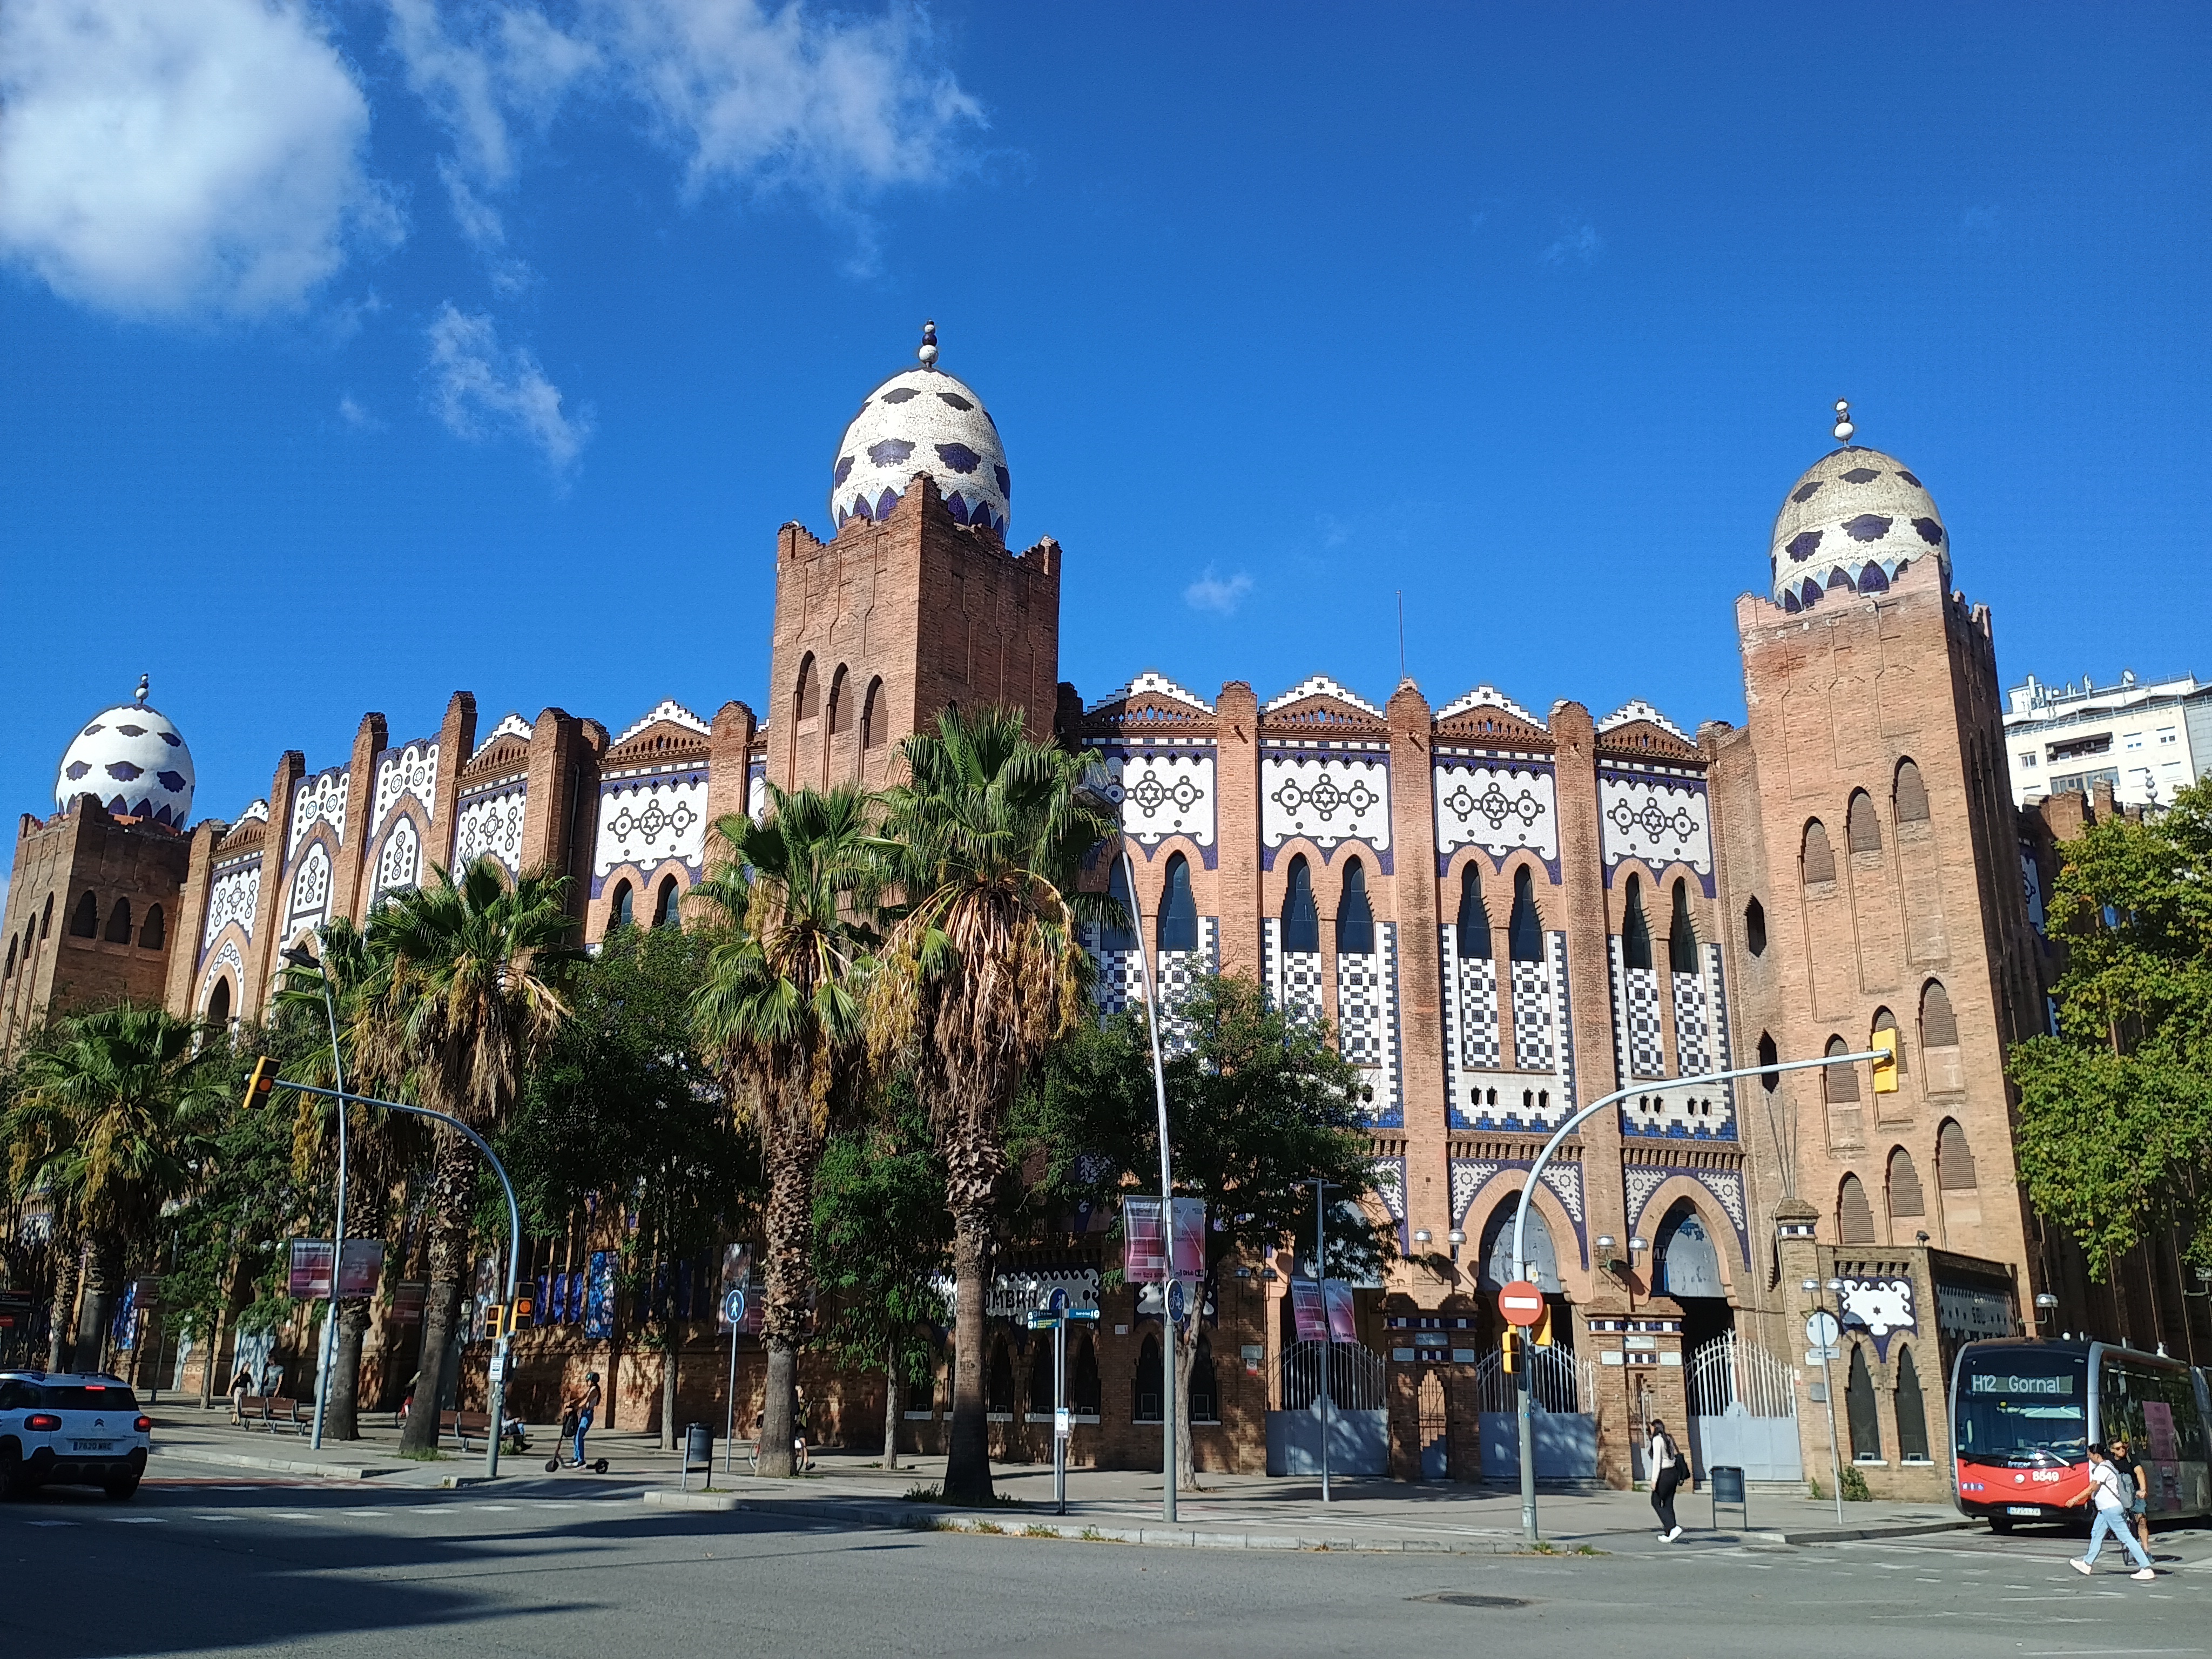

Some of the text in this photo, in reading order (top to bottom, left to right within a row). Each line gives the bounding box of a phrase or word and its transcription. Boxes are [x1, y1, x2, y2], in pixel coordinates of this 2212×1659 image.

[983, 1289, 1036, 1309] OMBRA
[1972, 1374, 2060, 1394] H12 Gornal
